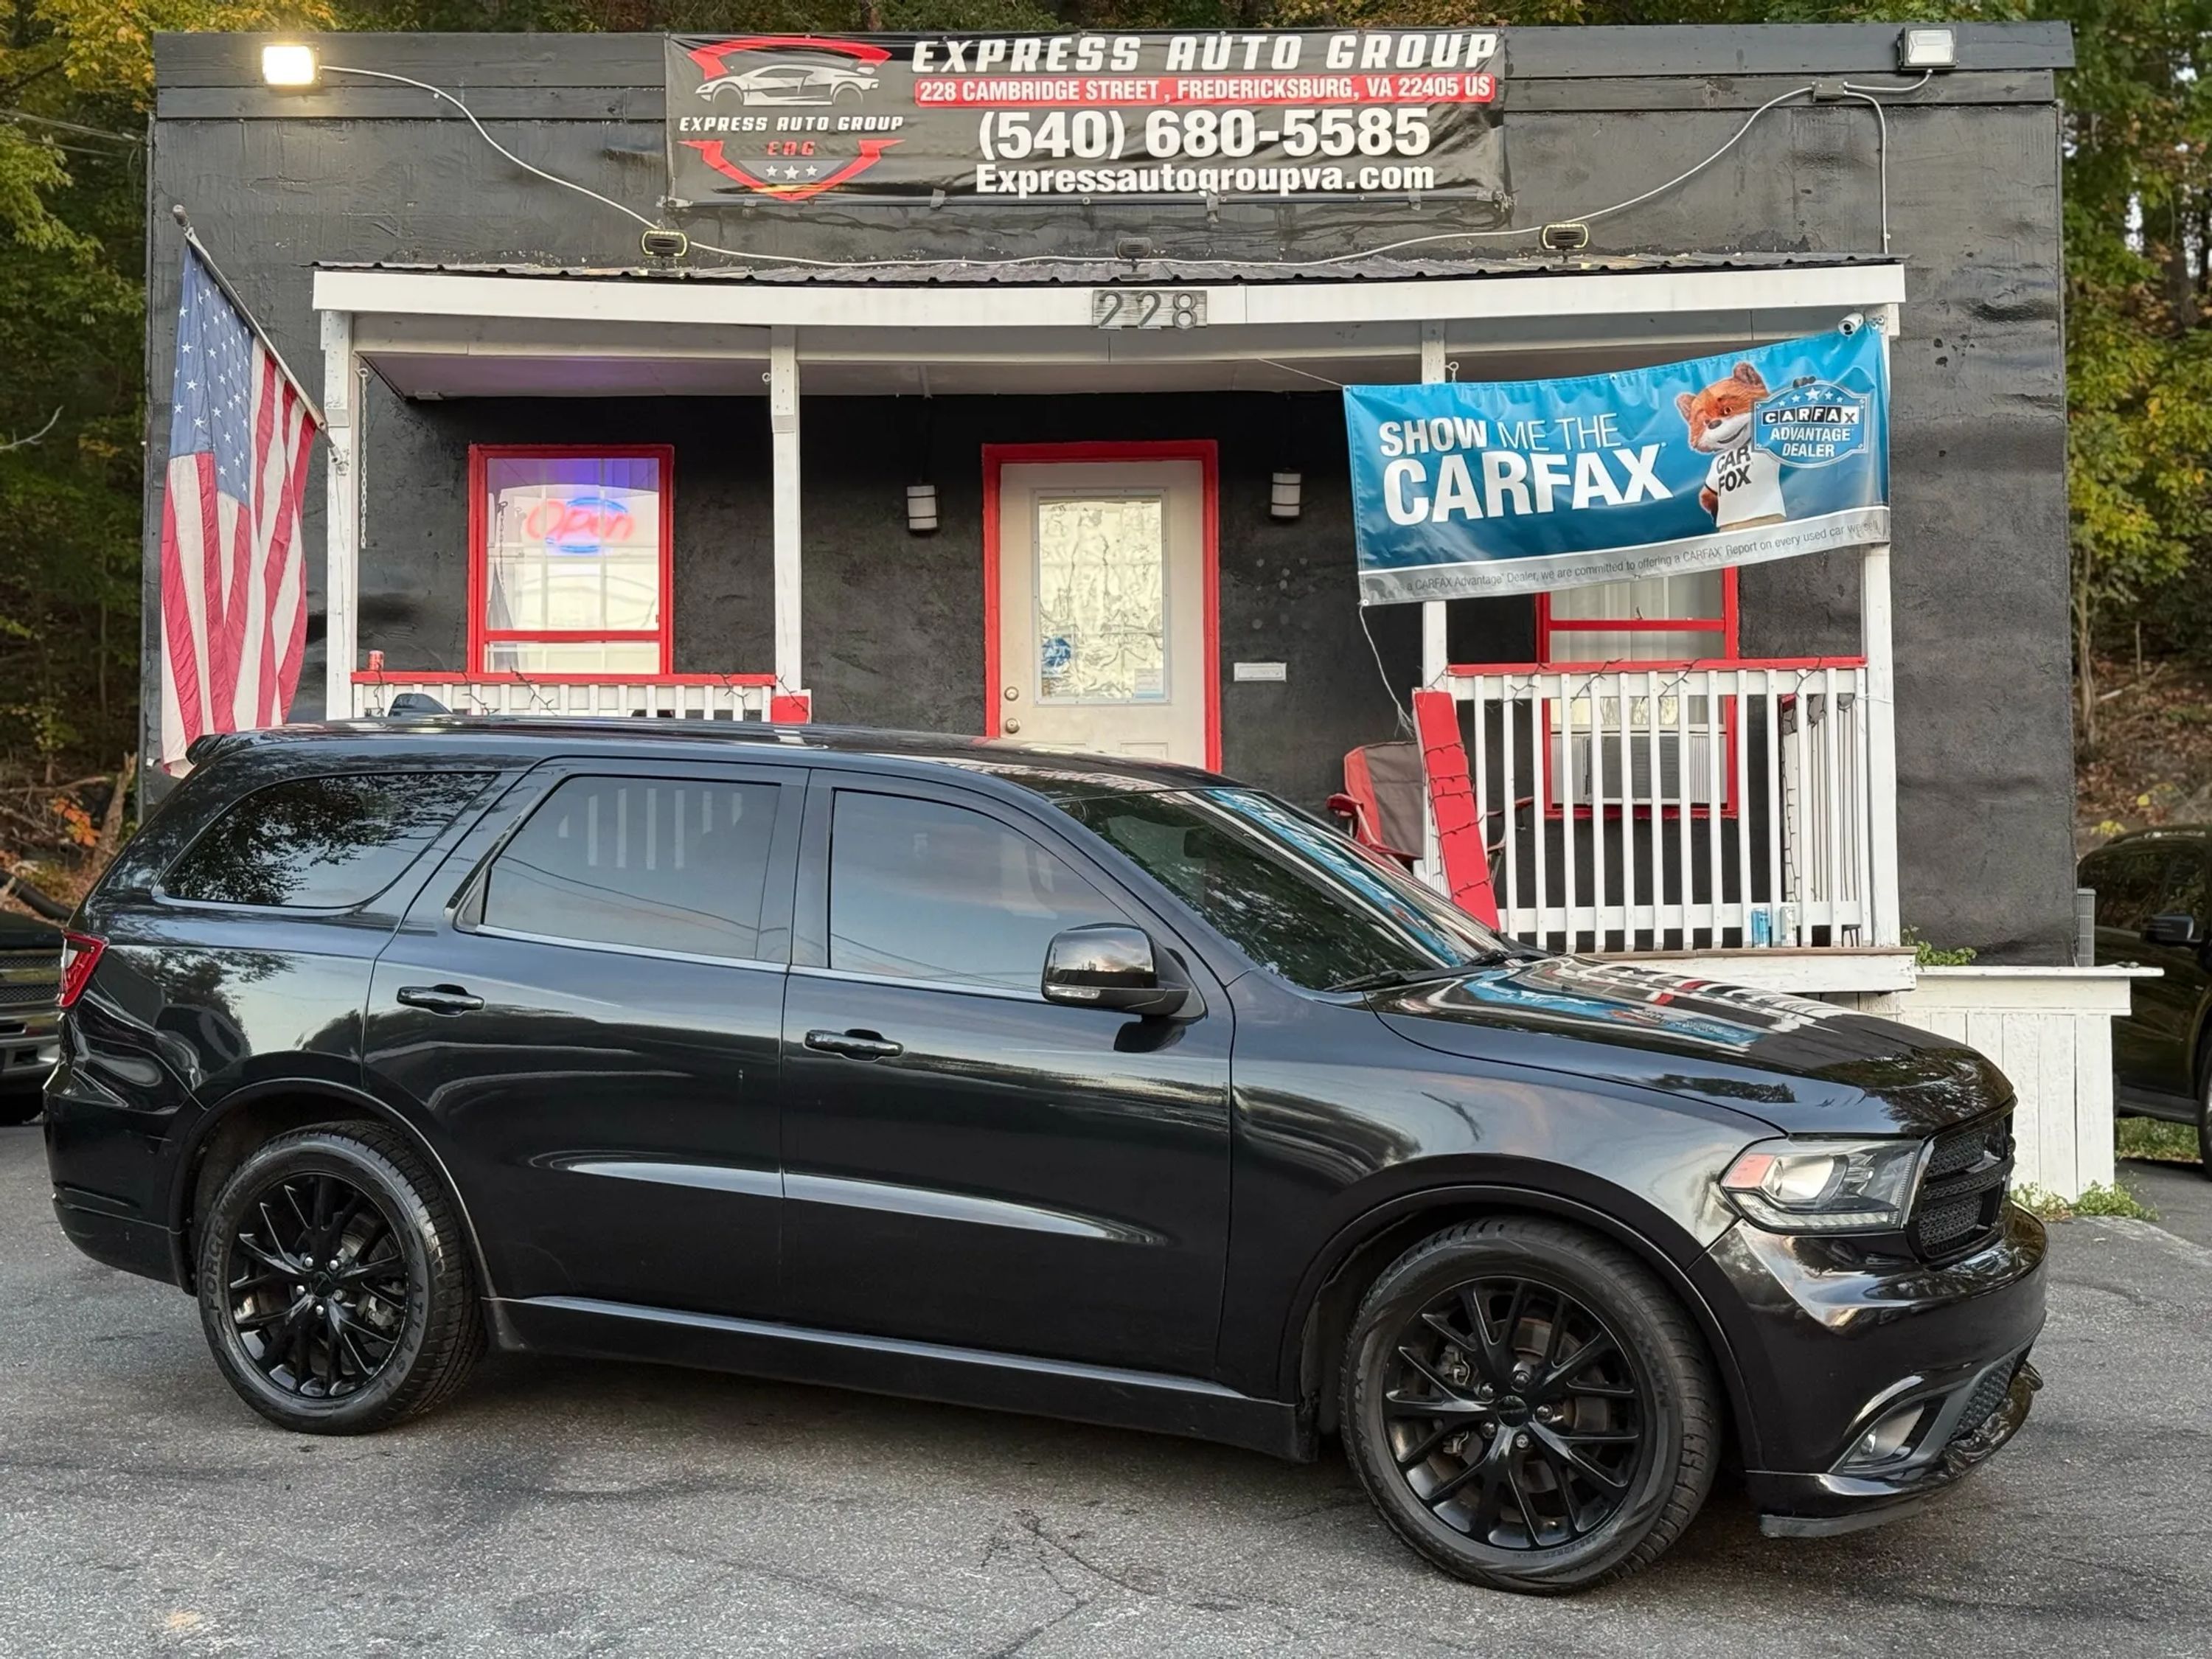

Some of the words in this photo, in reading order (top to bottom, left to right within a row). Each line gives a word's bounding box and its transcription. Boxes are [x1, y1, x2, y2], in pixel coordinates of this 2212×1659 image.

[912, 37, 1141, 72] EXPRESS
[1166, 35, 1303, 72] AUTO
[1325, 33, 1498, 69] GROUP
[920, 81, 956, 101] 228
[962, 80, 1080, 101] CAMBRIDGE
[1177, 77, 1360, 100] FREDERICKSBURG,
[1366, 77, 1393, 97] VA
[1398, 77, 1458, 97] 22405
[1464, 75, 1491, 96] US
[679, 116, 768, 131] EXPRESS
[776, 116, 830, 131] AUTO
[837, 116, 904, 131] GROUP
[979, 110, 1125, 161] (540)
[1145, 107, 1430, 159] 680-5585
[767, 141, 816, 156] EAG
[976, 163, 1435, 199] Expressautogroupva.com
[1099, 290, 1197, 330] 228
[1762, 406, 1859, 425] CARFAX
[1379, 416, 1487, 457] SHOW
[1498, 420, 1550, 451] ME
[1555, 412, 1621, 451] THE
[1770, 426, 1851, 442] ADVANTAGE
[1782, 442, 1835, 458] DEALER
[1717, 445, 1751, 474] CAR
[1383, 442, 1674, 526] CARFAX
[1719, 465, 1752, 497] FOX
[1415, 577, 1453, 590] CARFAX
[1507, 571, 1539, 584] Dealer,
[1541, 571, 1554, 580] we
[1557, 568, 1572, 579] are
[1574, 560, 1623, 577] committed
[1626, 560, 1635, 571] to
[1638, 555, 1672, 570] offering
[1683, 548, 1721, 562] CARFAX
[1726, 543, 1757, 557] Report
[1760, 540, 1773, 551] on
[1775, 535, 1801, 549] every
[1804, 530, 1826, 543] used
[1829, 526, 1844, 537] car
